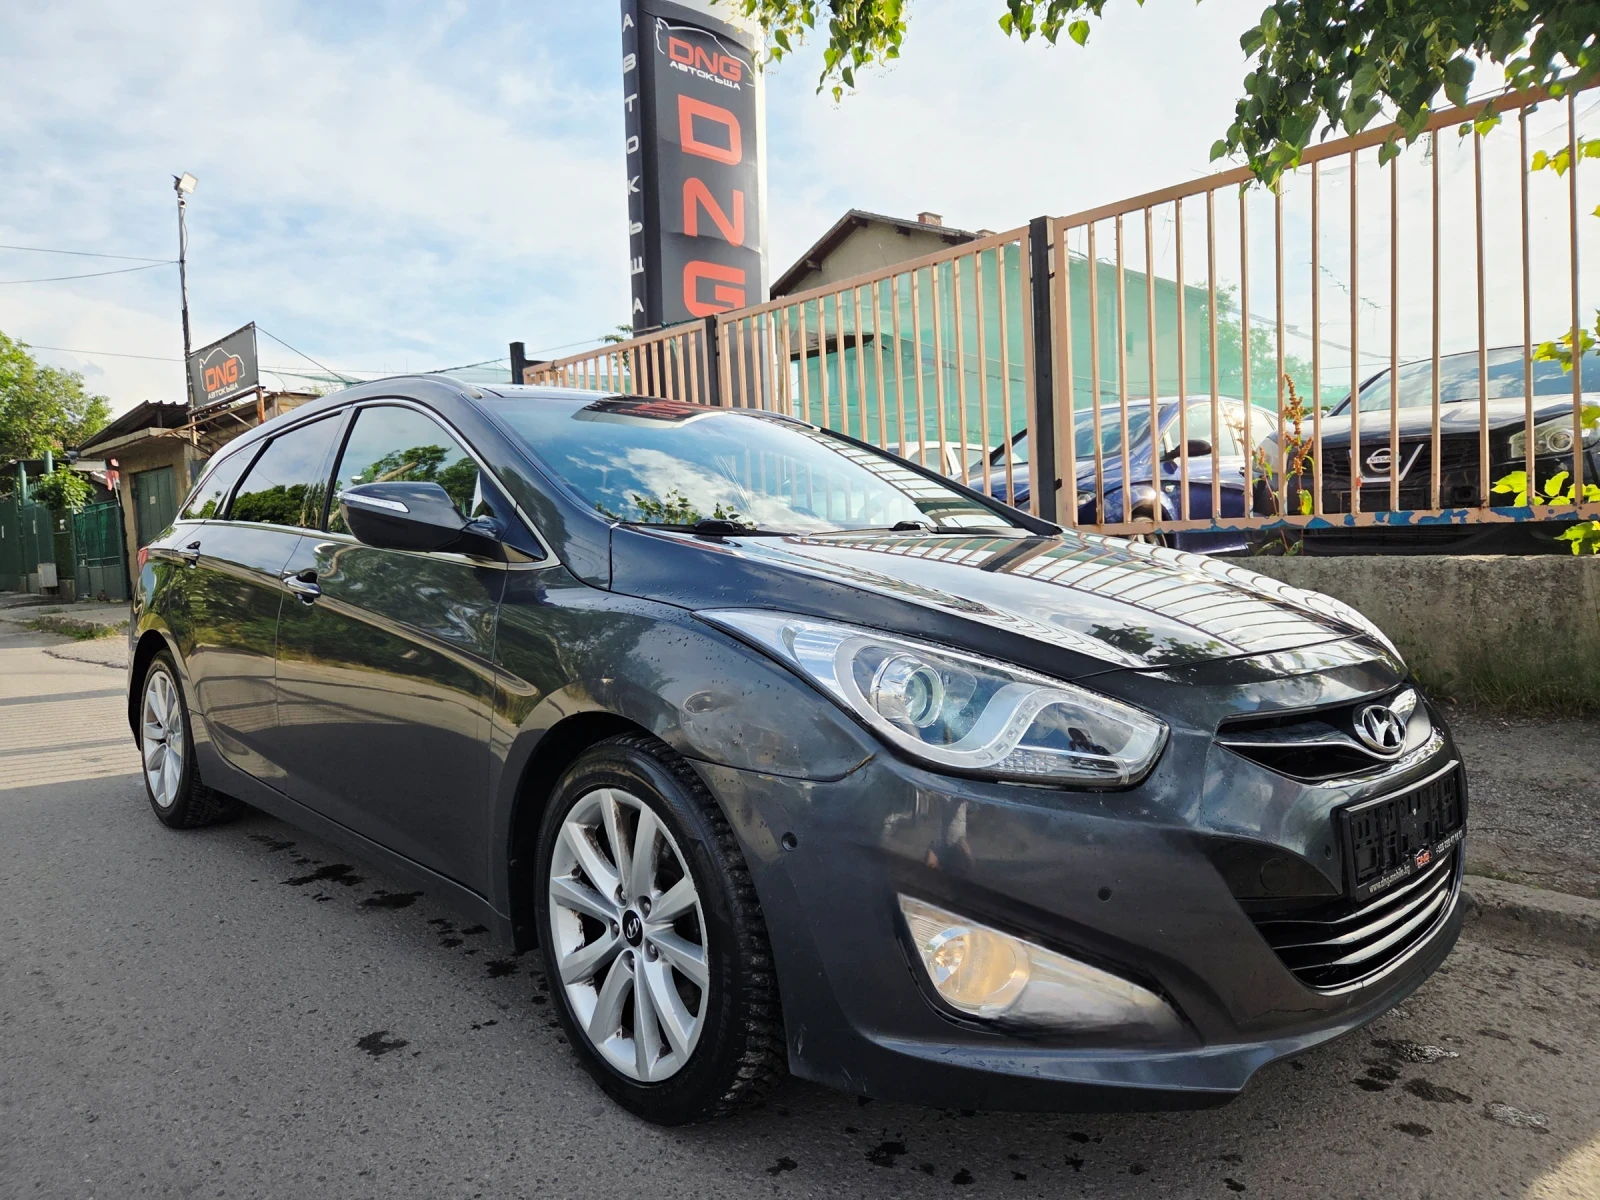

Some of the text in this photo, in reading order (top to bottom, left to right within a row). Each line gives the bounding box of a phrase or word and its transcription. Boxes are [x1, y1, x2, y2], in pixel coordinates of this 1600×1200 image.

[668, 36, 742, 82] DNG
[669, 60, 741, 91] АВТОКЪЩА
[622, 13, 644, 315] АВТОКЪЩА
[677, 93, 746, 318] DNG
[205, 357, 238, 392] DNG
